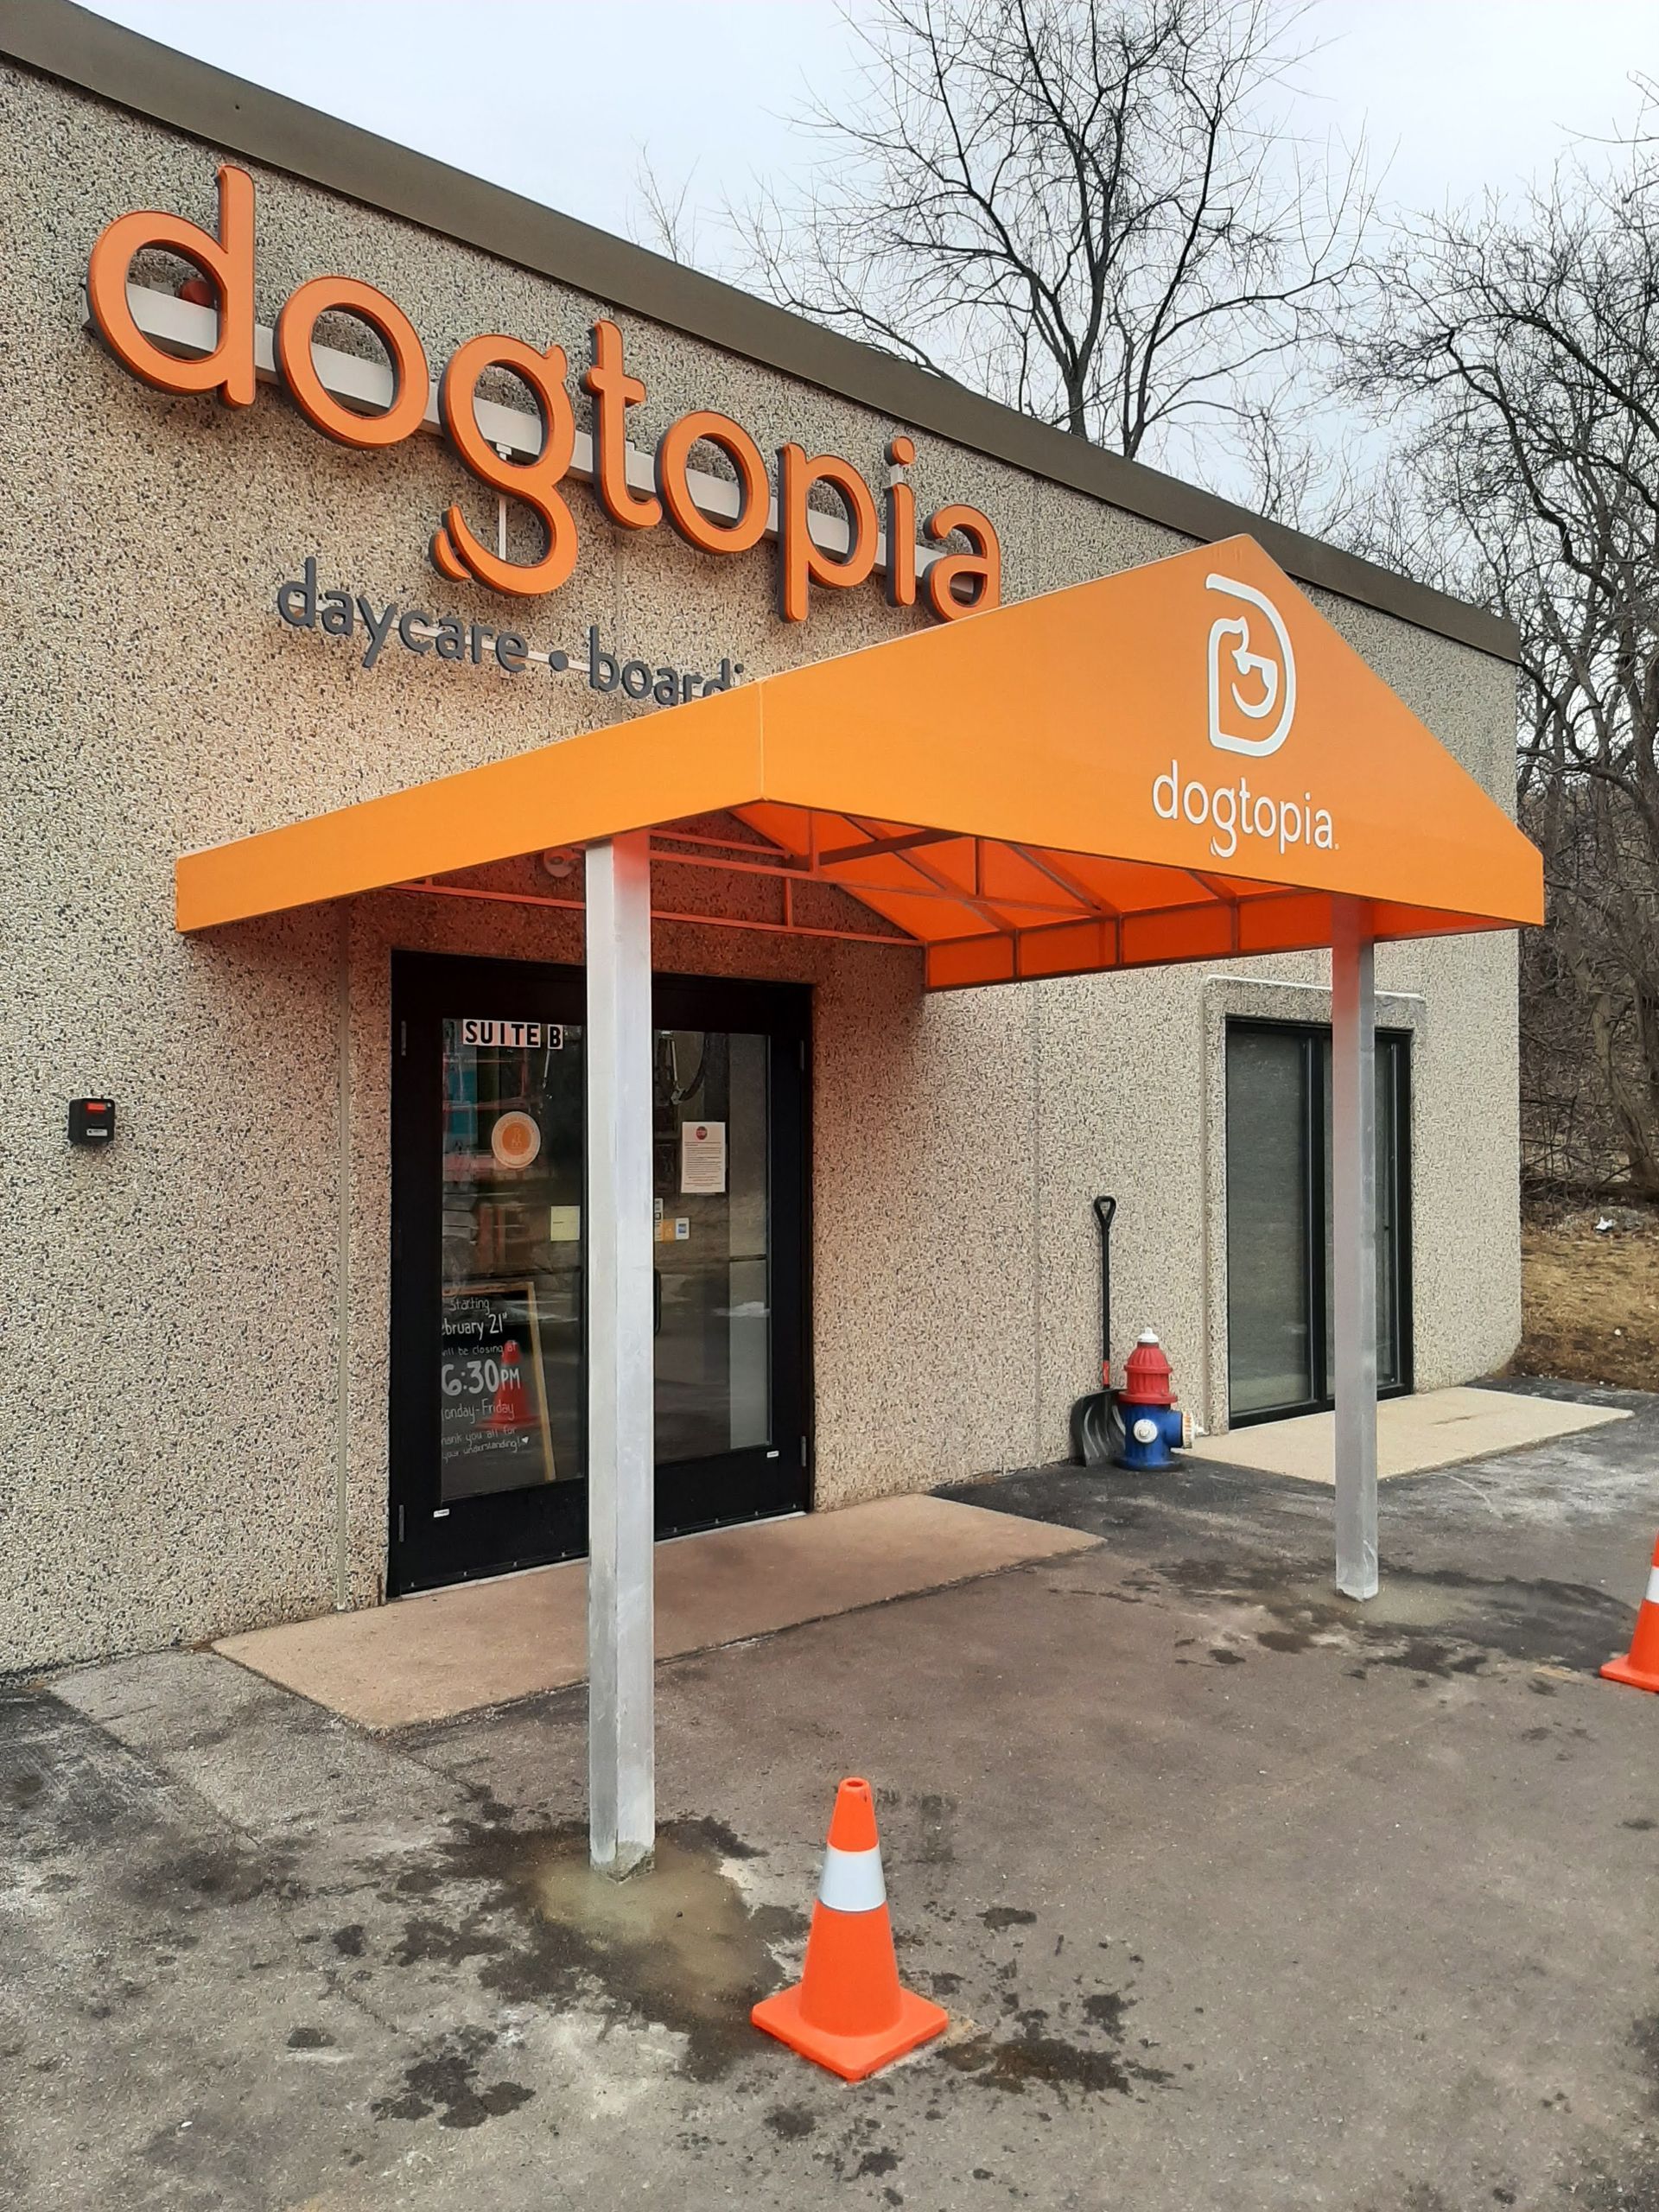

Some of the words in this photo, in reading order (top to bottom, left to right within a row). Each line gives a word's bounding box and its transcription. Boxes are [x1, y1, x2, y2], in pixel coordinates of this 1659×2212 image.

[86, 163, 1001, 623] dogtopia
[277, 556, 529, 673] daycare
[589, 625, 744, 706] board
[1153, 759, 1333, 858] dogtopia
[465, 1020, 539, 1046] SUITE
[550, 1026, 561, 1048] B
[449, 1297, 490, 1315] Starting
[458, 1347, 469, 1356] be
[472, 1344, 505, 1357] closing
[442, 1398, 515, 1424] onday-Friday
[466, 1431, 482, 1447] you
[486, 1428, 499, 1439] all
[503, 1425, 518, 1435] for
